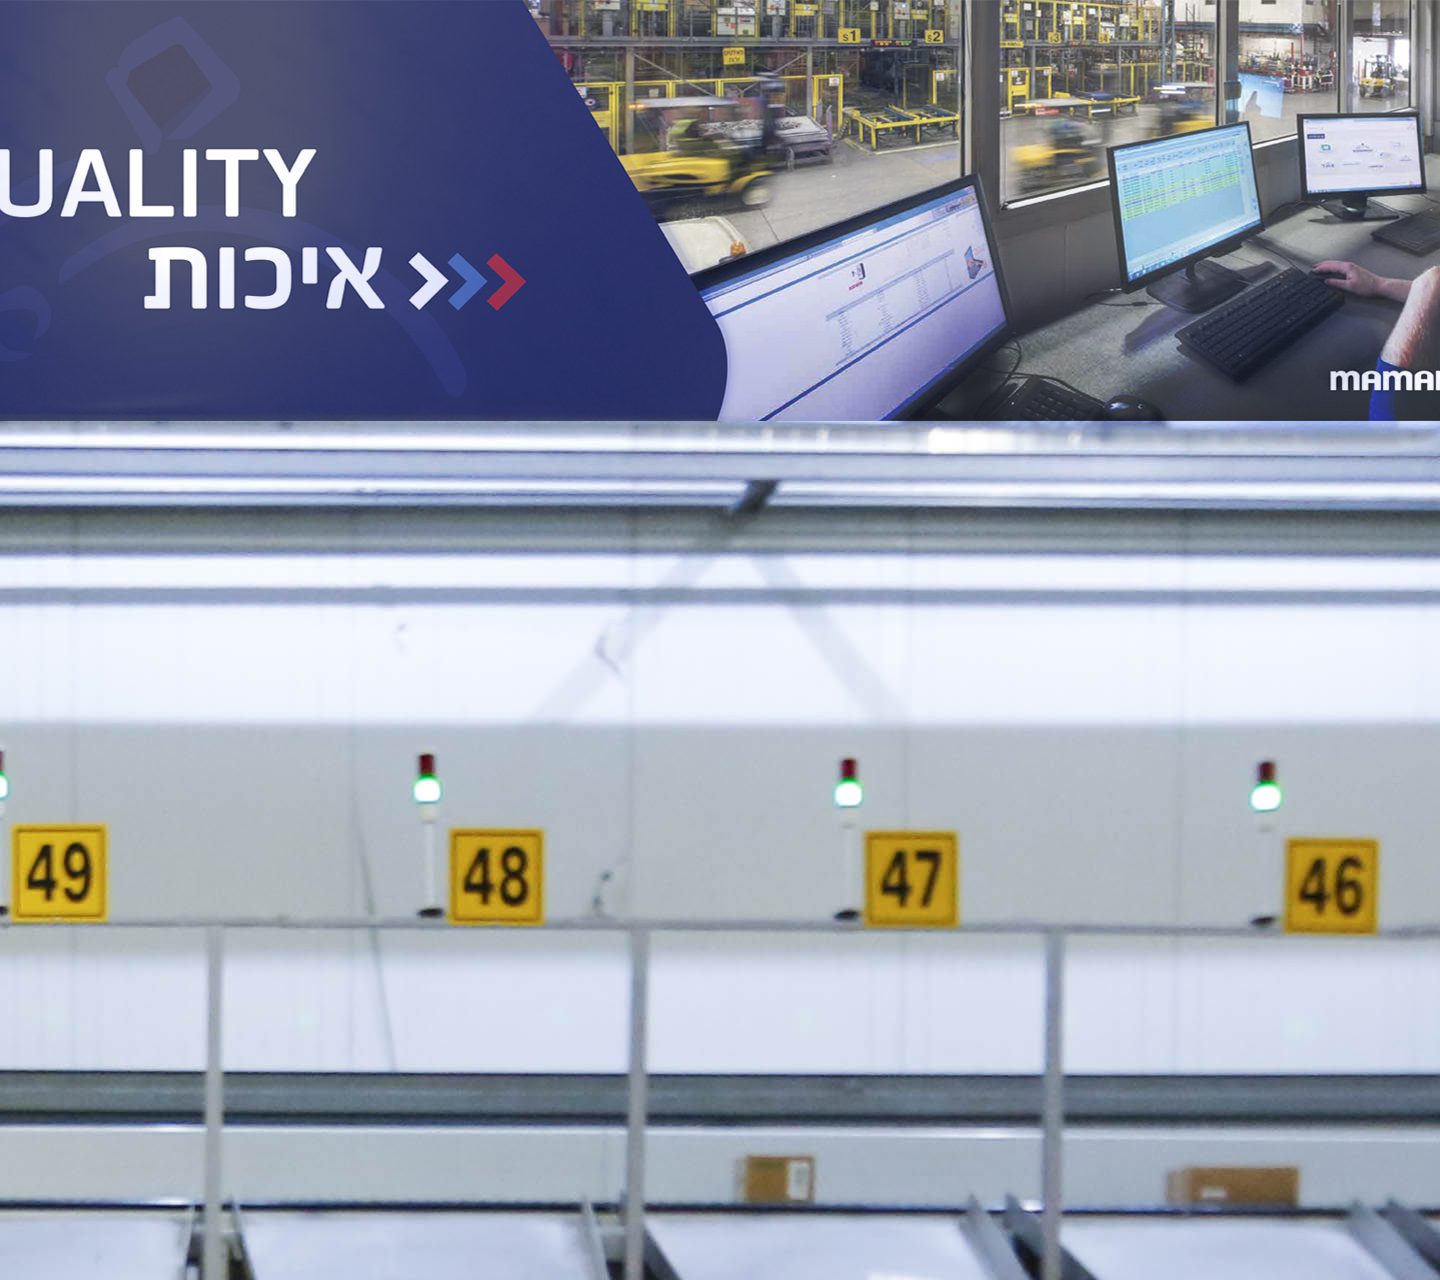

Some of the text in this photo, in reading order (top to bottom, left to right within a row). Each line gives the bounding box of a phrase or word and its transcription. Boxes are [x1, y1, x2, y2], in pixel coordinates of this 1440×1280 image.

[144, 246, 386, 310] איכות
[26, 842, 92, 903] 49
[463, 845, 529, 908] 48
[878, 848, 944, 909] 47
[1297, 855, 1364, 918] 46
